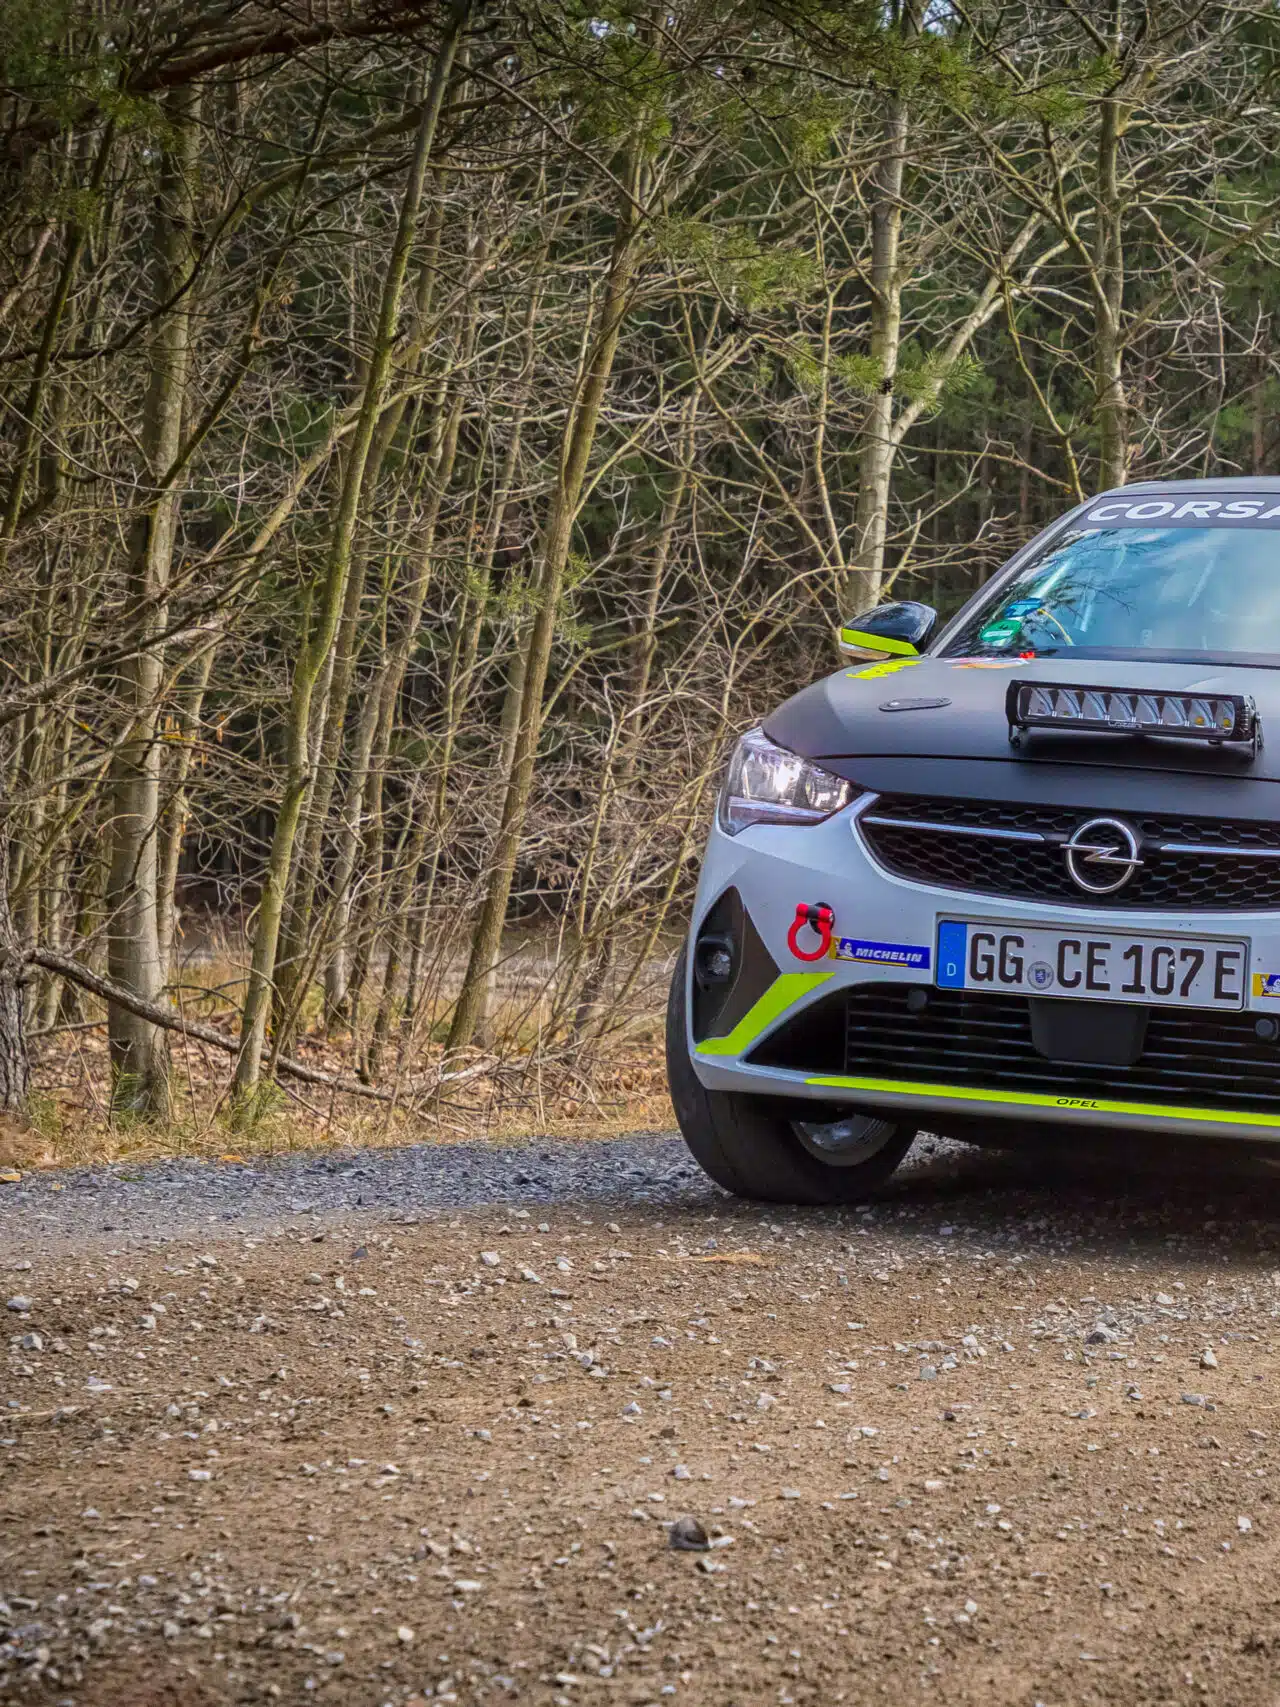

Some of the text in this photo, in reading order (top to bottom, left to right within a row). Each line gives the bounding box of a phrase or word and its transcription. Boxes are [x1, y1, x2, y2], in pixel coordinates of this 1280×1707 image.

[854, 946, 924, 963] MICHELIN
[970, 932, 1025, 984] GG
[1056, 939, 1111, 991] CE
[946, 962, 957, 977] D
[1056, 1096, 1100, 1109] OPEL
